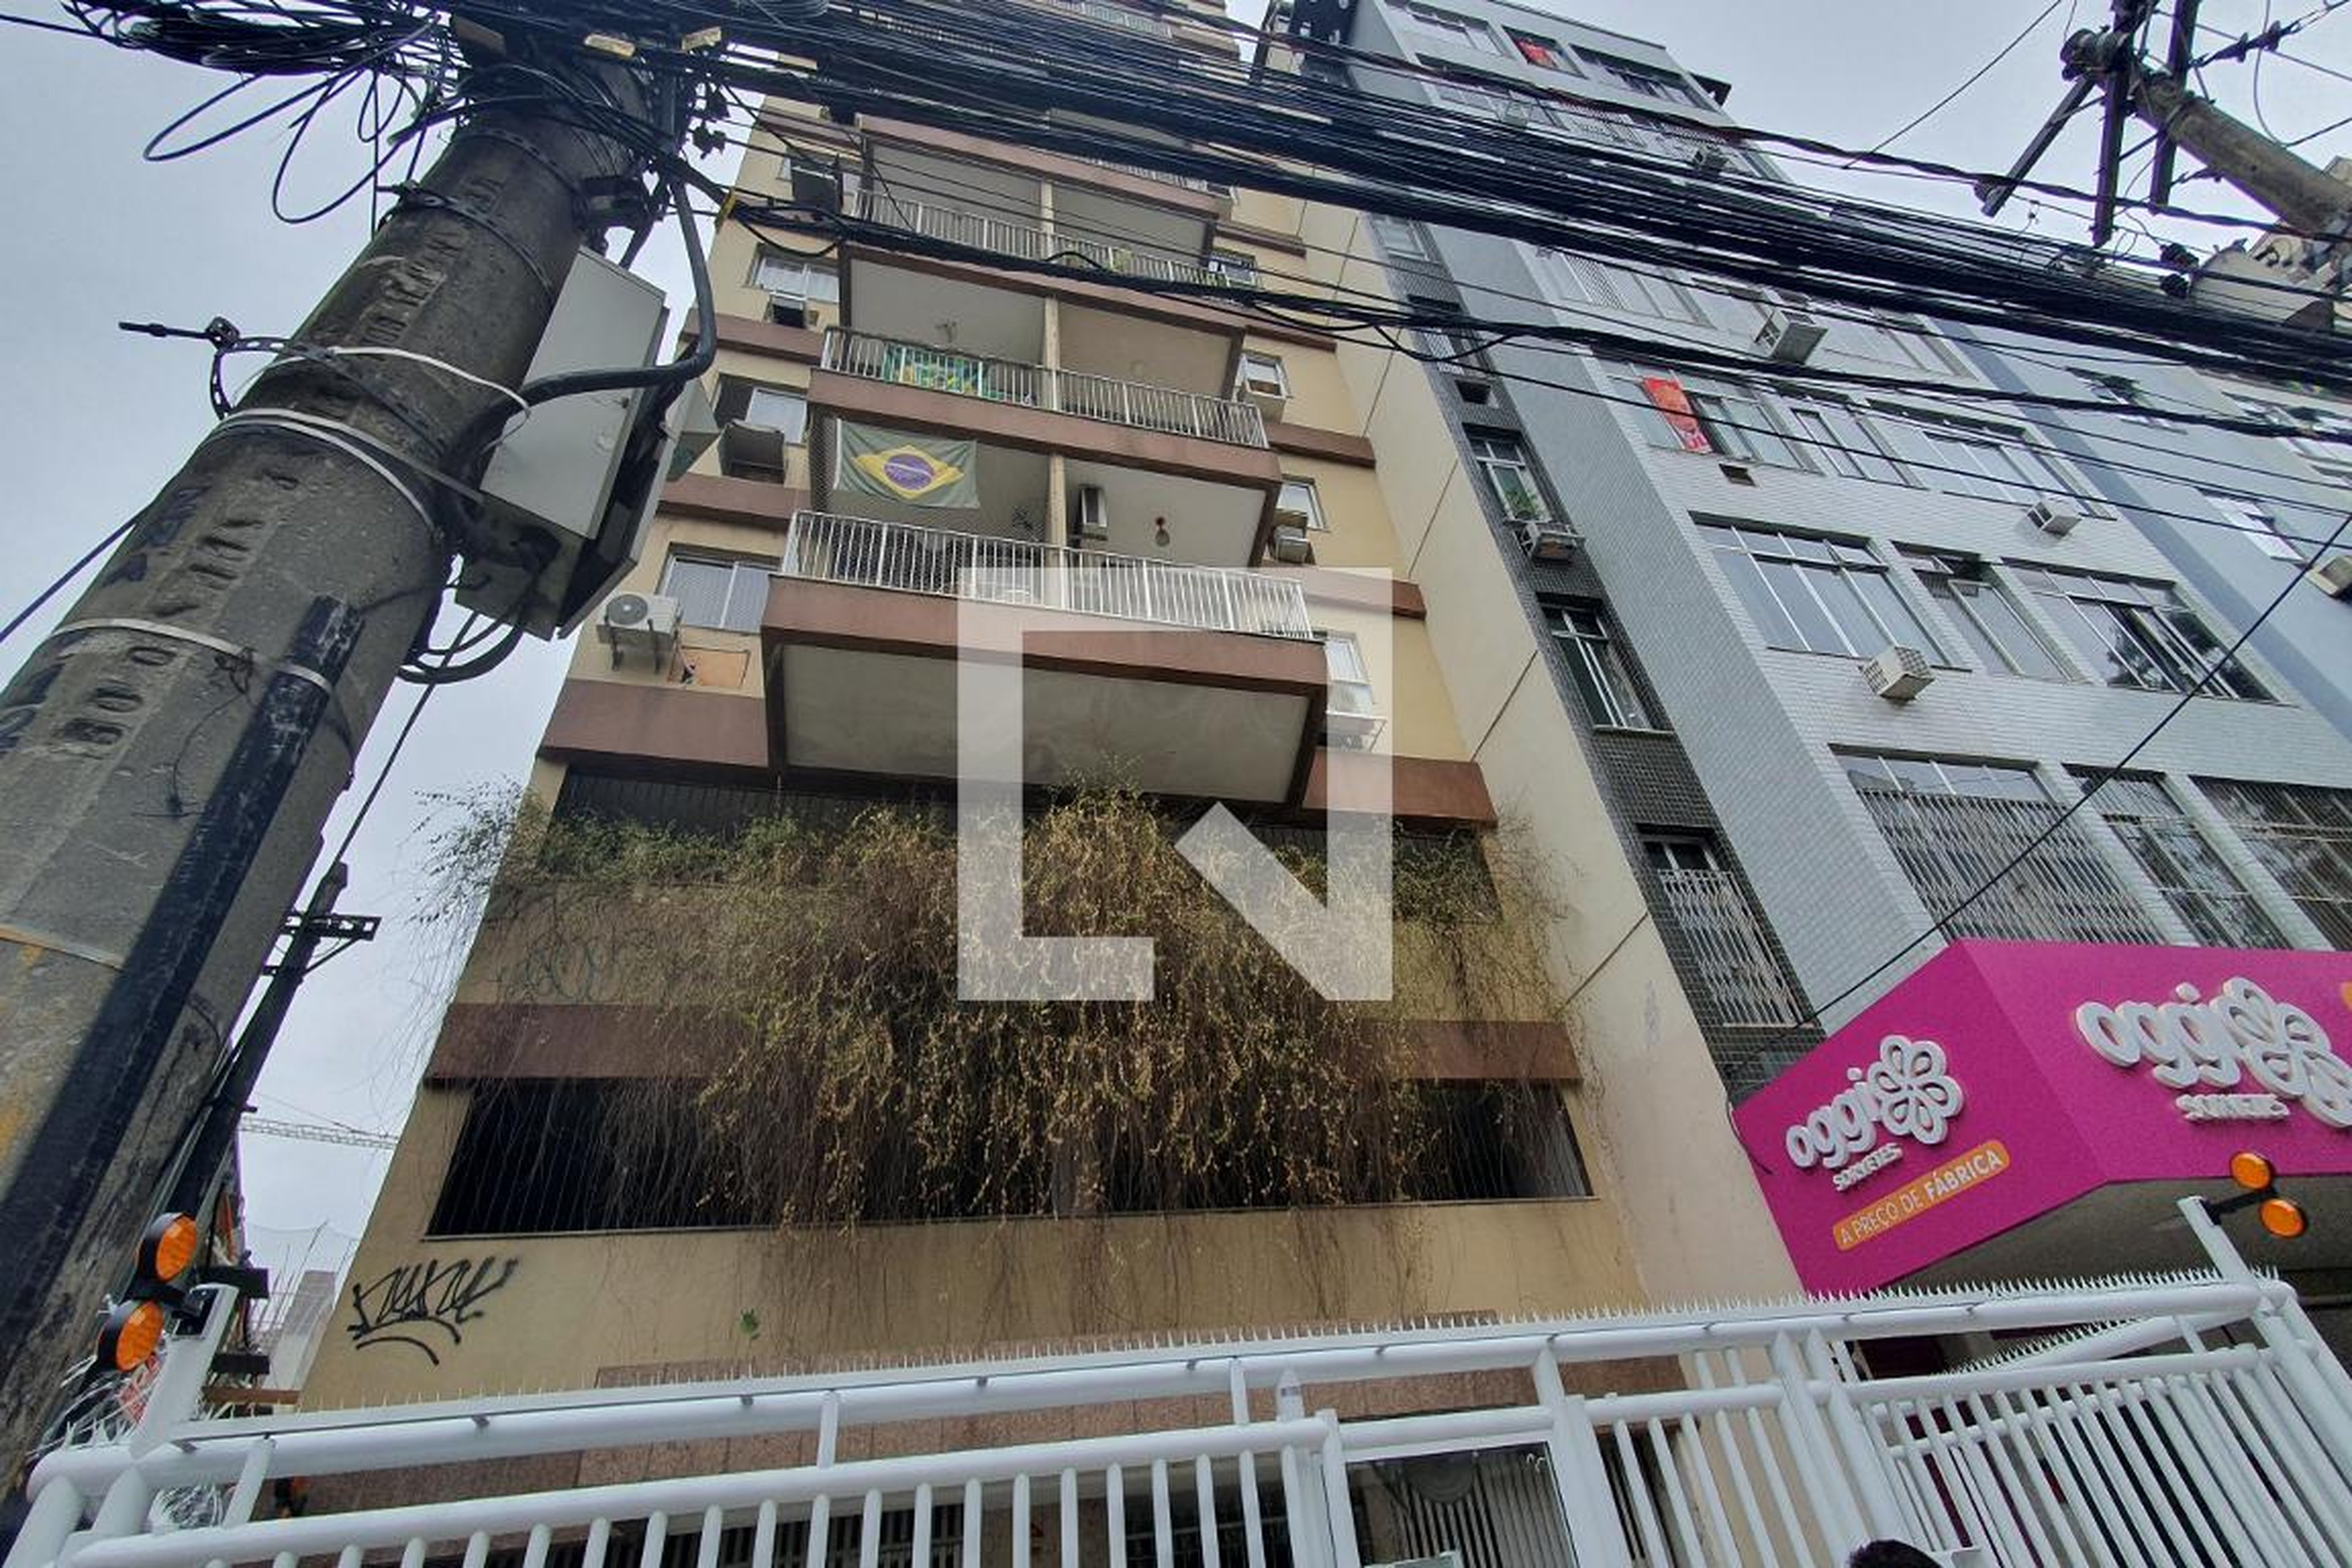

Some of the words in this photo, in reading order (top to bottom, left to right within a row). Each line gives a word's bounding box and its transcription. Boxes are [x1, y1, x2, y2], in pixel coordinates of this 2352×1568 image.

[2076, 982, 2242, 1088] oggi
[1786, 1067, 1882, 1168] oggi
[1841, 1226, 1853, 1244] A
[1850, 1203, 1899, 1239] PREÇO
[1899, 1189, 1924, 1213] DE
[1924, 1149, 2003, 1201] FÁBRICA
